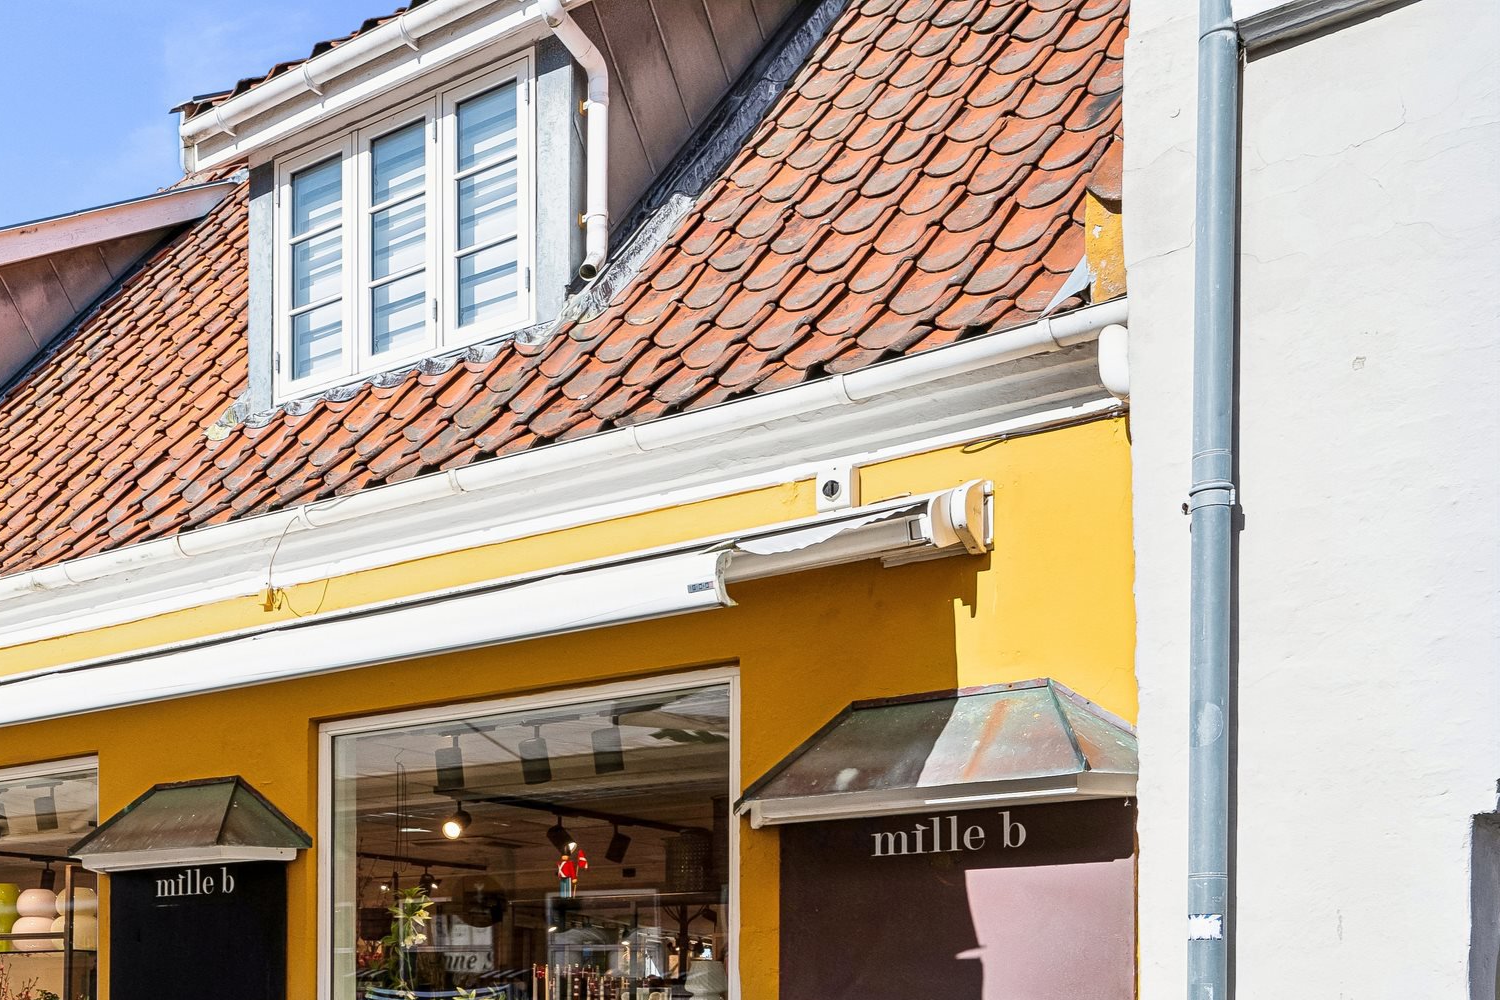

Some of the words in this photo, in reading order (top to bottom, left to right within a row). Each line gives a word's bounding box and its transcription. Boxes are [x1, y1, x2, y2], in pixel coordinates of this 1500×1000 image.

[870, 815, 986, 857] mille
[997, 810, 1027, 849] b
[155, 868, 215, 898] mille
[219, 866, 235, 894] b
